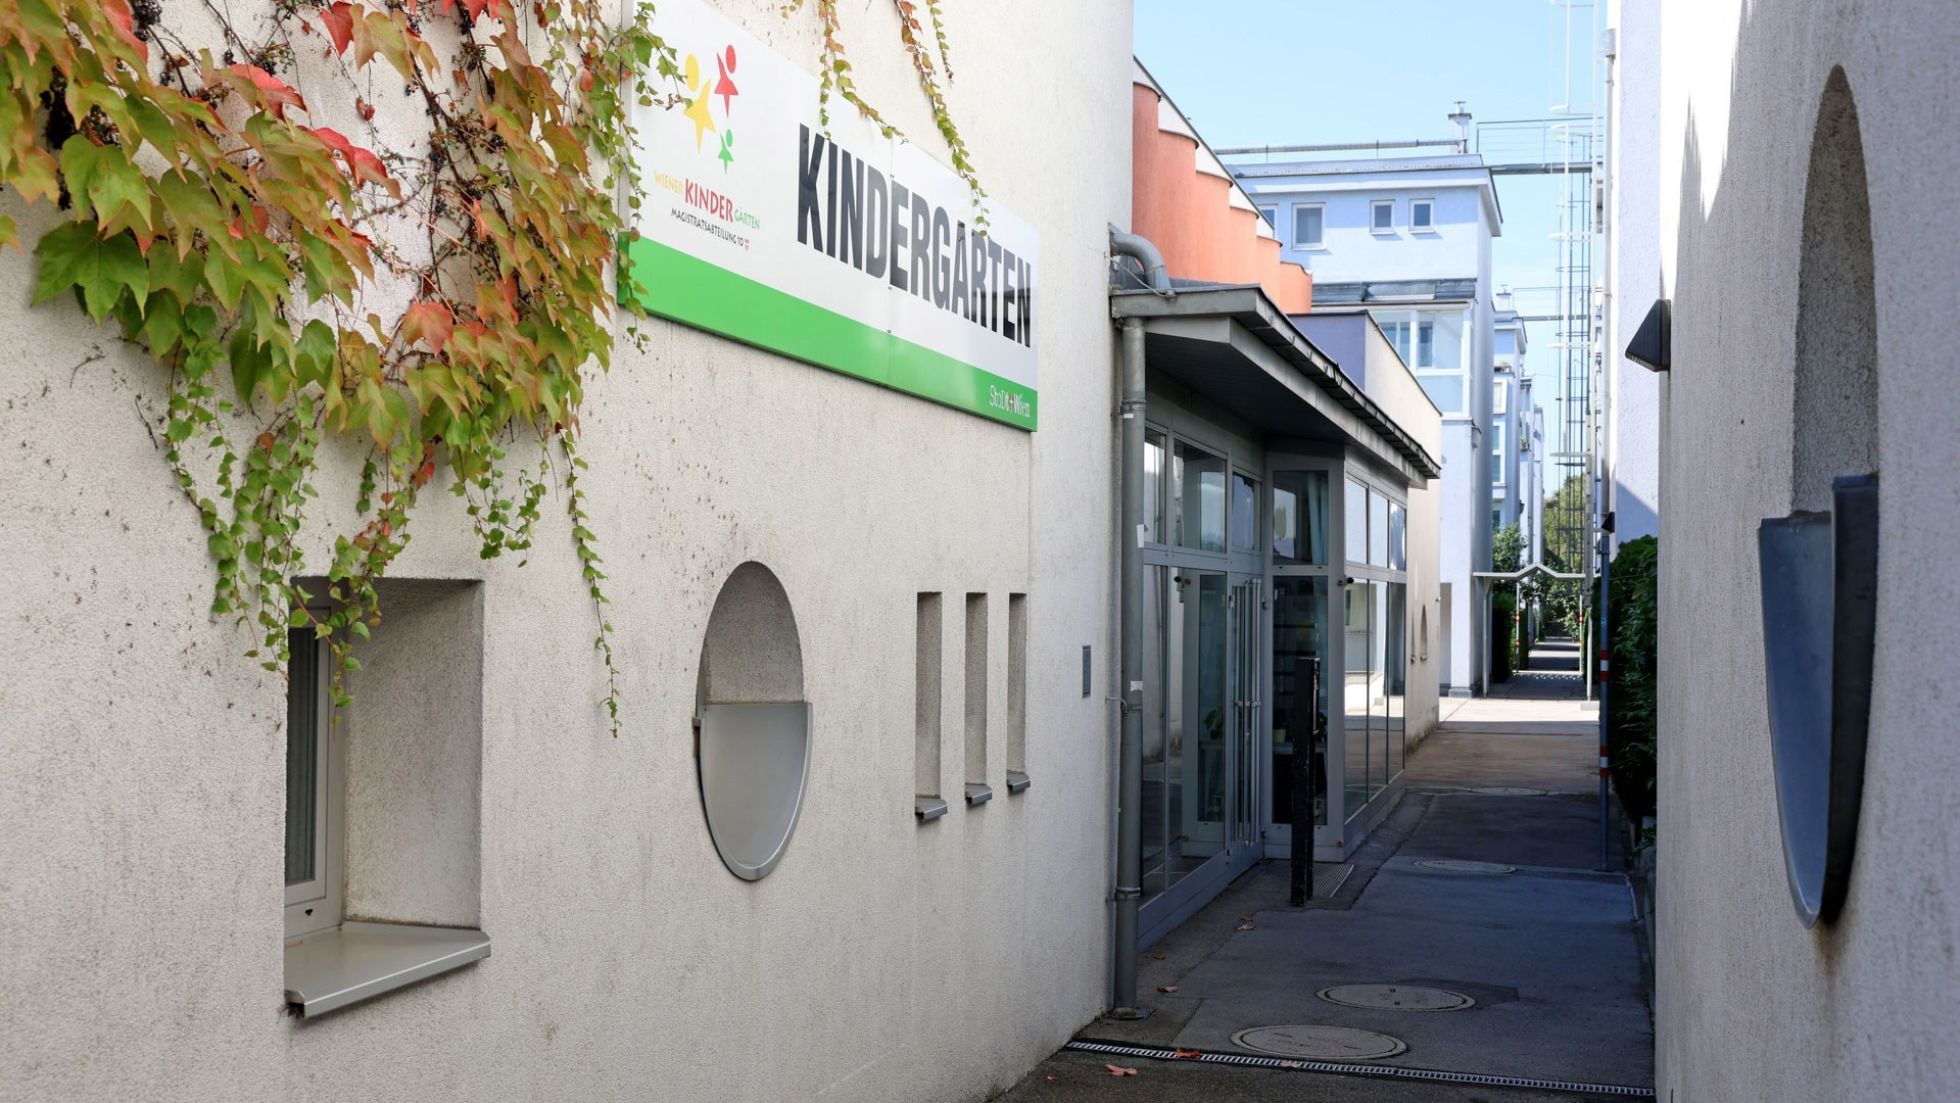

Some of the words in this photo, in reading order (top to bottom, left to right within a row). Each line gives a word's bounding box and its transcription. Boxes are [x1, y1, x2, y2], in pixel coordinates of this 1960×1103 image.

[654, 172, 683, 194] WIENER
[685, 178, 734, 223] KINDER
[734, 208, 760, 230] GARTEN
[671, 207, 737, 245] MAGISTRATSABTEILUNG
[797, 122, 1031, 348] KINDERGARTEN
